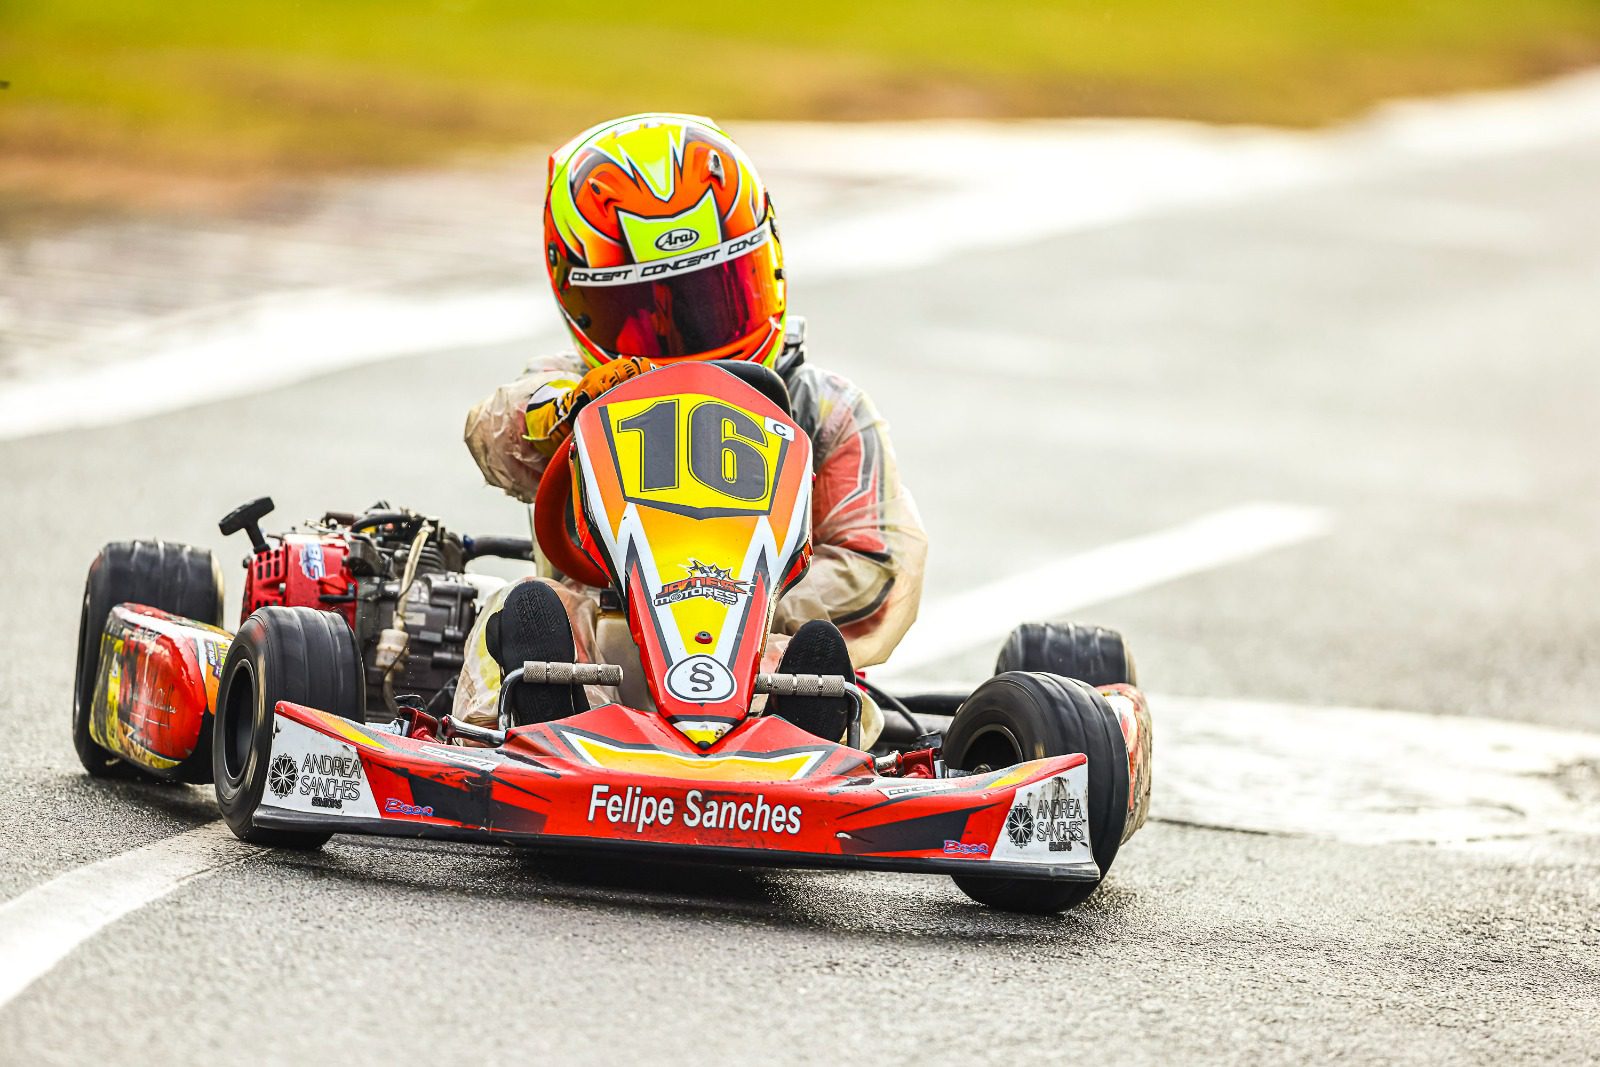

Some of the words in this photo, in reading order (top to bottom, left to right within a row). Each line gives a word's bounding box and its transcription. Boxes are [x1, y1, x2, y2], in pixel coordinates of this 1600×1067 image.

[659, 231, 694, 248] Arai
[571, 269, 633, 282] CONCEPT
[640, 249, 721, 278] CONCEPT
[773, 423, 787, 437] C
[617, 399, 770, 502] 16
[301, 753, 361, 779] ANDREA
[300, 775, 360, 801] SANCHES
[588, 784, 675, 833] Felipe
[683, 790, 802, 835] Sanches
[1036, 798, 1083, 820] ANDREA
